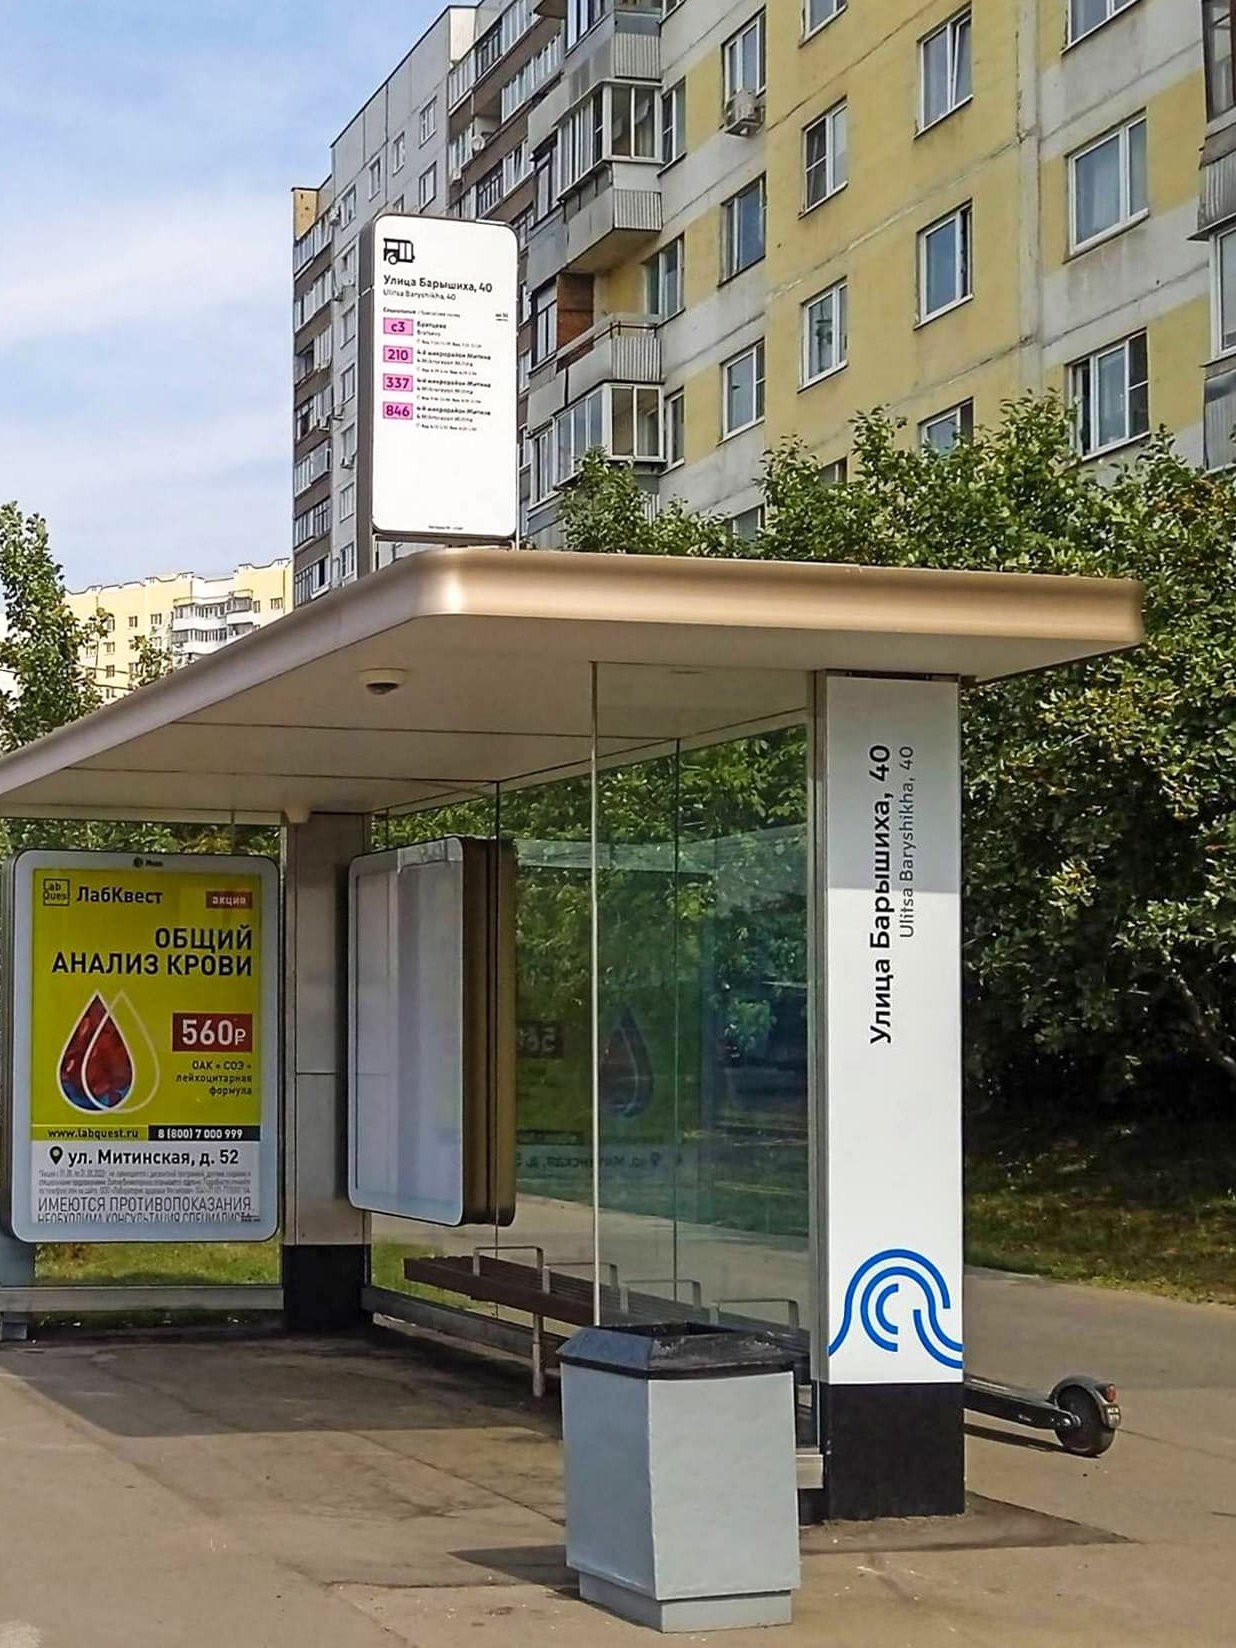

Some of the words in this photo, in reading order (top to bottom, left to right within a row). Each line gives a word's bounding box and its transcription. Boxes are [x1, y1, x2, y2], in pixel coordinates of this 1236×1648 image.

[383, 275, 416, 287] Улица
[419, 278, 477, 293] Барышиха,
[479, 282, 493, 293] 40
[388, 349, 409, 361] 210
[386, 377, 409, 389] 337
[386, 405, 410, 417] 846
[869, 745, 890, 782] 40
[899, 746, 914, 771] 40
[899, 777, 916, 881] Baryshikha,
[870, 793, 895, 948] Барышиха,
[76, 886, 163, 905] ЛабКвест
[212, 896, 247, 906] акция
[900, 888, 914, 938] Ulitsa
[155, 924, 252, 953] ОБЩИЙ
[52, 952, 159, 974] АНАЛИЗ
[167, 954, 252, 976] КРОВИ
[870, 959, 894, 1044] Улица
[192, 1060, 212, 1070] ОАК
[176, 1073, 252, 1084] лейкоцитарная
[209, 1086, 252, 1096] формула
[47, 1128, 139, 1140] www.labquest.ru
[158, 1129, 164, 1139] 8
[167, 1128, 193, 1140] (800)
[195, 1129, 201, 1139] 7
[204, 1129, 222, 1139] 000
[225, 1129, 243, 1139] 999
[68, 1152, 92, 1167] ул.
[98, 1150, 195, 1167] Митинская,
[199, 1152, 214, 1167] д.
[220, 1150, 239, 1165] 52
[38, 1196, 106, 1212] ИМЕЮТСЯ
[109, 1196, 251, 1212] ПРОТИВОПОКАЗАНИЯ
